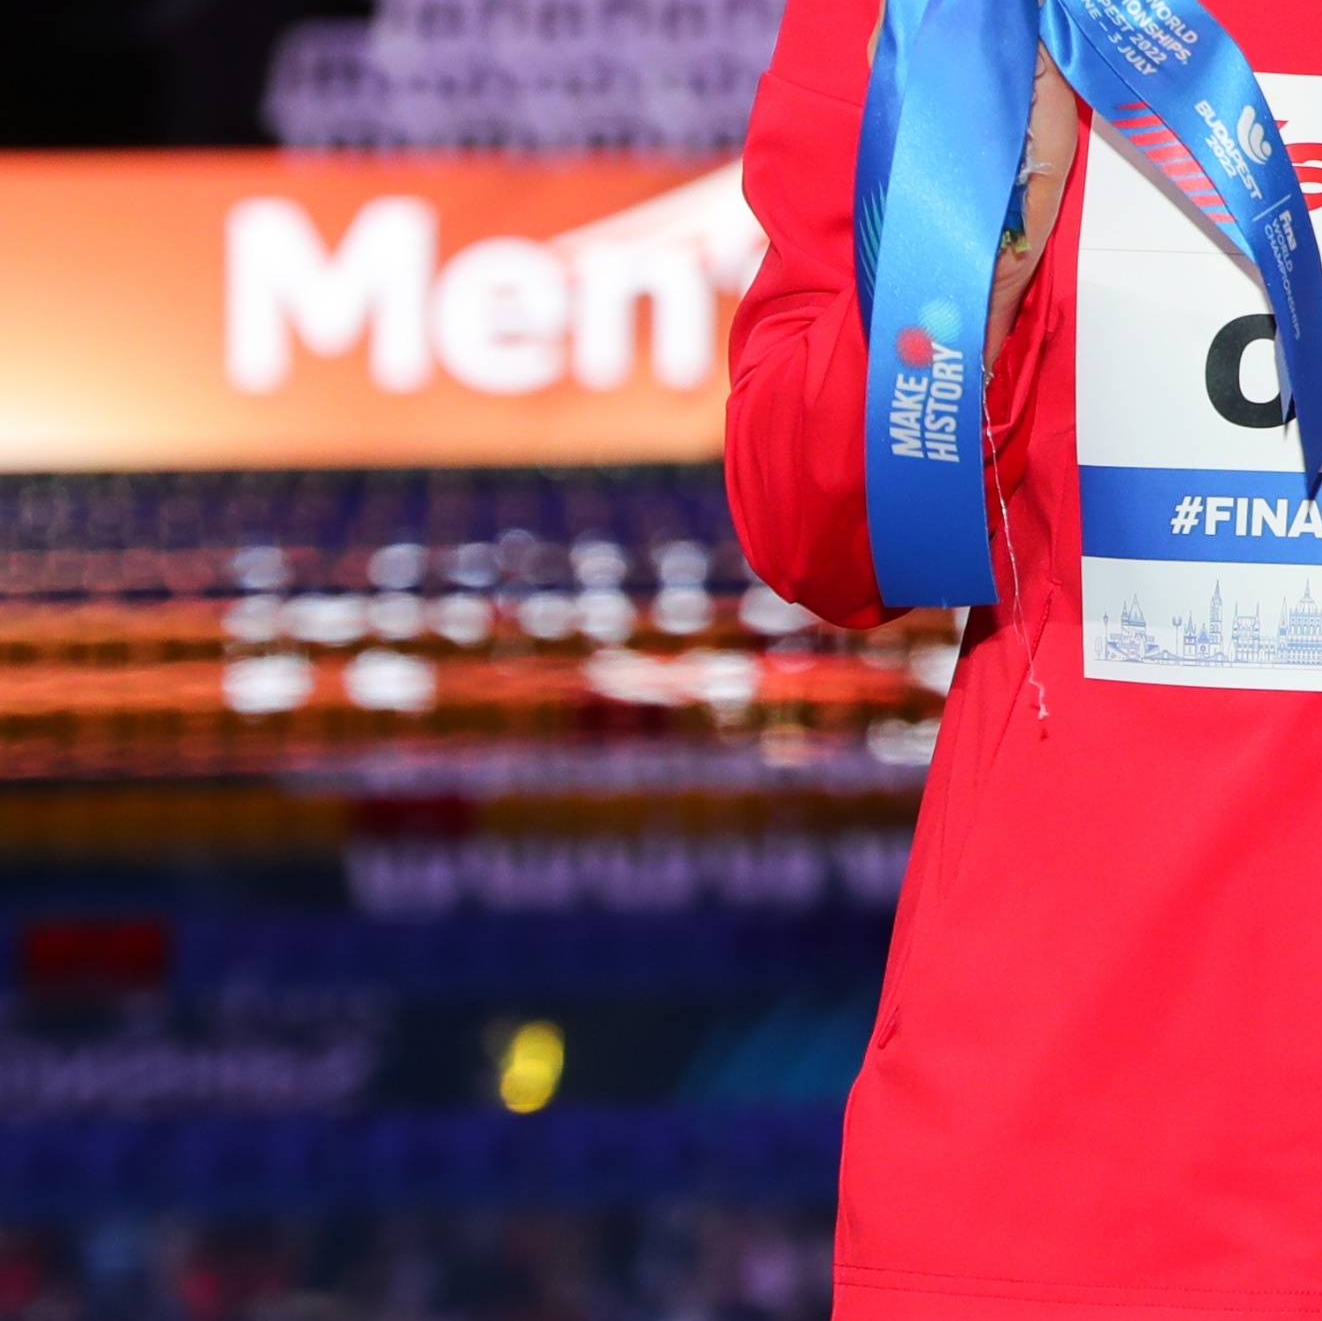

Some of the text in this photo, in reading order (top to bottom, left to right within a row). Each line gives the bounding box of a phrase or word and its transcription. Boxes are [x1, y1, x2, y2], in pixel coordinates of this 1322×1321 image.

[1108, 31, 1121, 44] 3
[1118, 45, 1158, 77] JULY
[1128, 33, 1169, 66] 2022
[1193, 99, 1263, 200] BUDAPEST
[1205, 135, 1238, 179] 2022
[1271, 218, 1294, 273] WORLD
[1279, 209, 1298, 253] Fina
[1264, 224, 1301, 341] CHAMPIONSHIPS
[889, 373, 929, 459] MAKE
[923, 340, 965, 463] HISTORY
